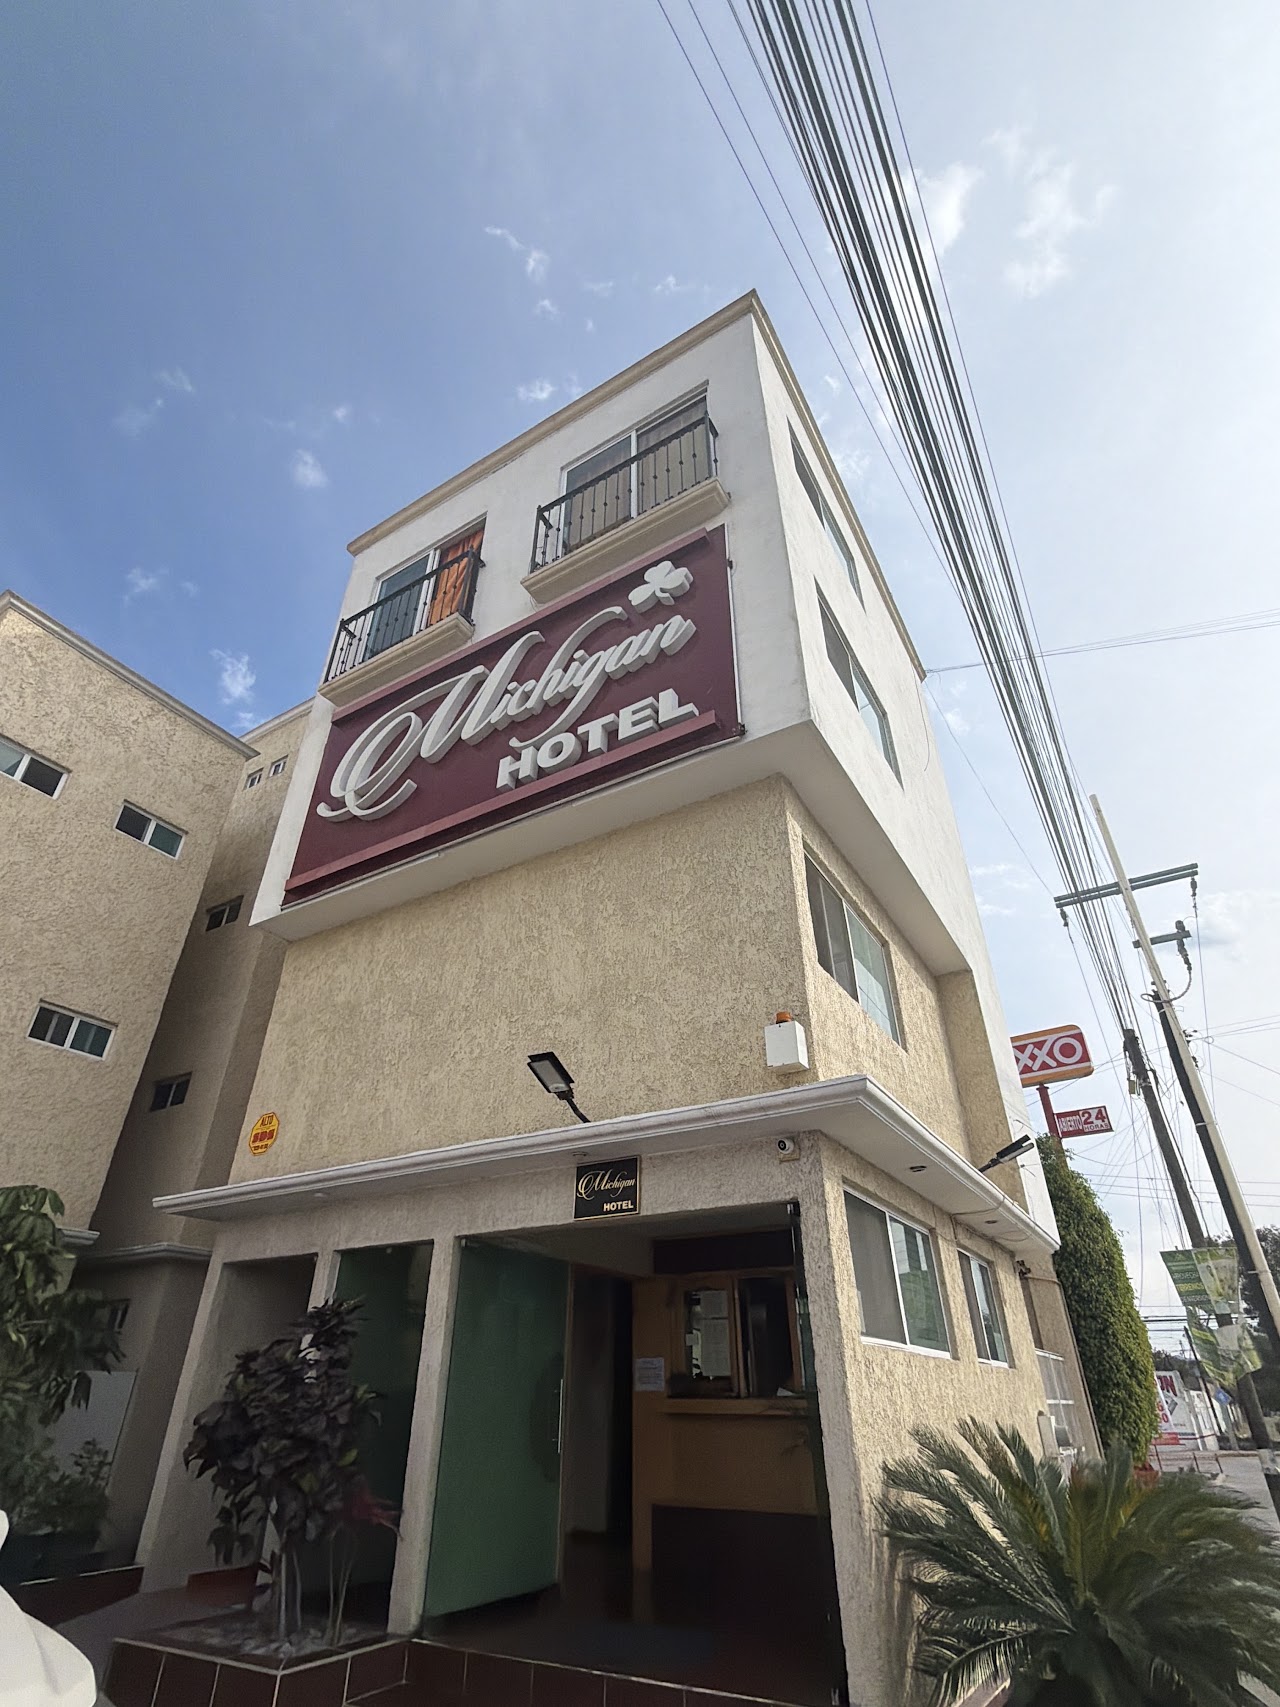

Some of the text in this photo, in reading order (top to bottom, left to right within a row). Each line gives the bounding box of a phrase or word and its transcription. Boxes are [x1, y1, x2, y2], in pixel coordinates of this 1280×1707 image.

[316, 606, 697, 822] Michigan
[496, 688, 700, 790] HOTEL
[1013, 1036, 1083, 1071] XXO
[1082, 1109, 1107, 1125] 24
[1084, 1123, 1109, 1131] HORAS
[576, 1168, 636, 1201] Michigan
[603, 1200, 634, 1211] HOTEL
